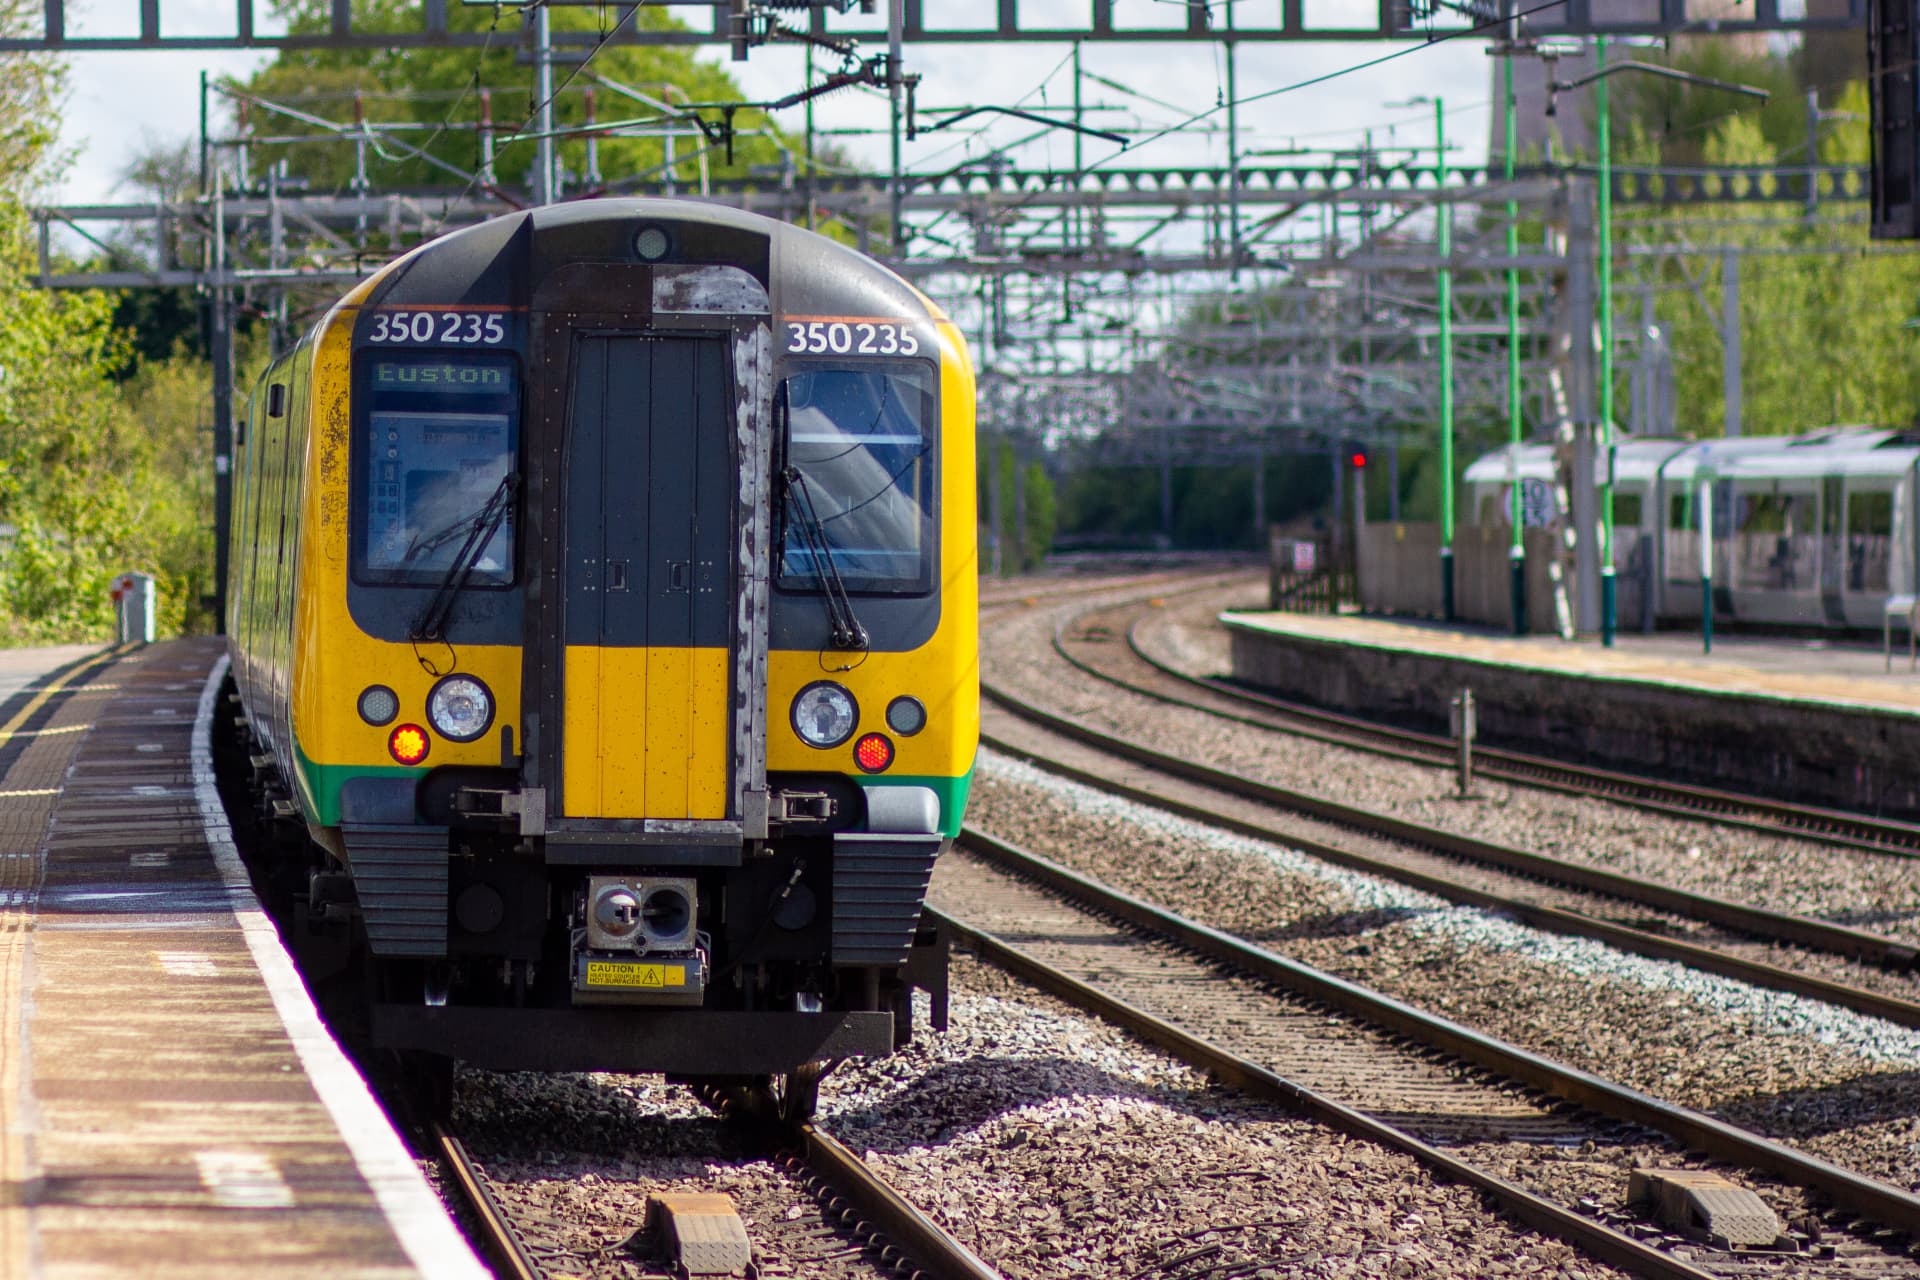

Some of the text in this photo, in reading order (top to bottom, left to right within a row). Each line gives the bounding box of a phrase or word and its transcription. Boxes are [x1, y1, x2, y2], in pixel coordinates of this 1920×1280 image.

[370, 312, 504, 344] 350 235
[787, 322, 919, 355] 350 235
[378, 363, 501, 383] Euston
[590, 964, 635, 973] CAUTION
